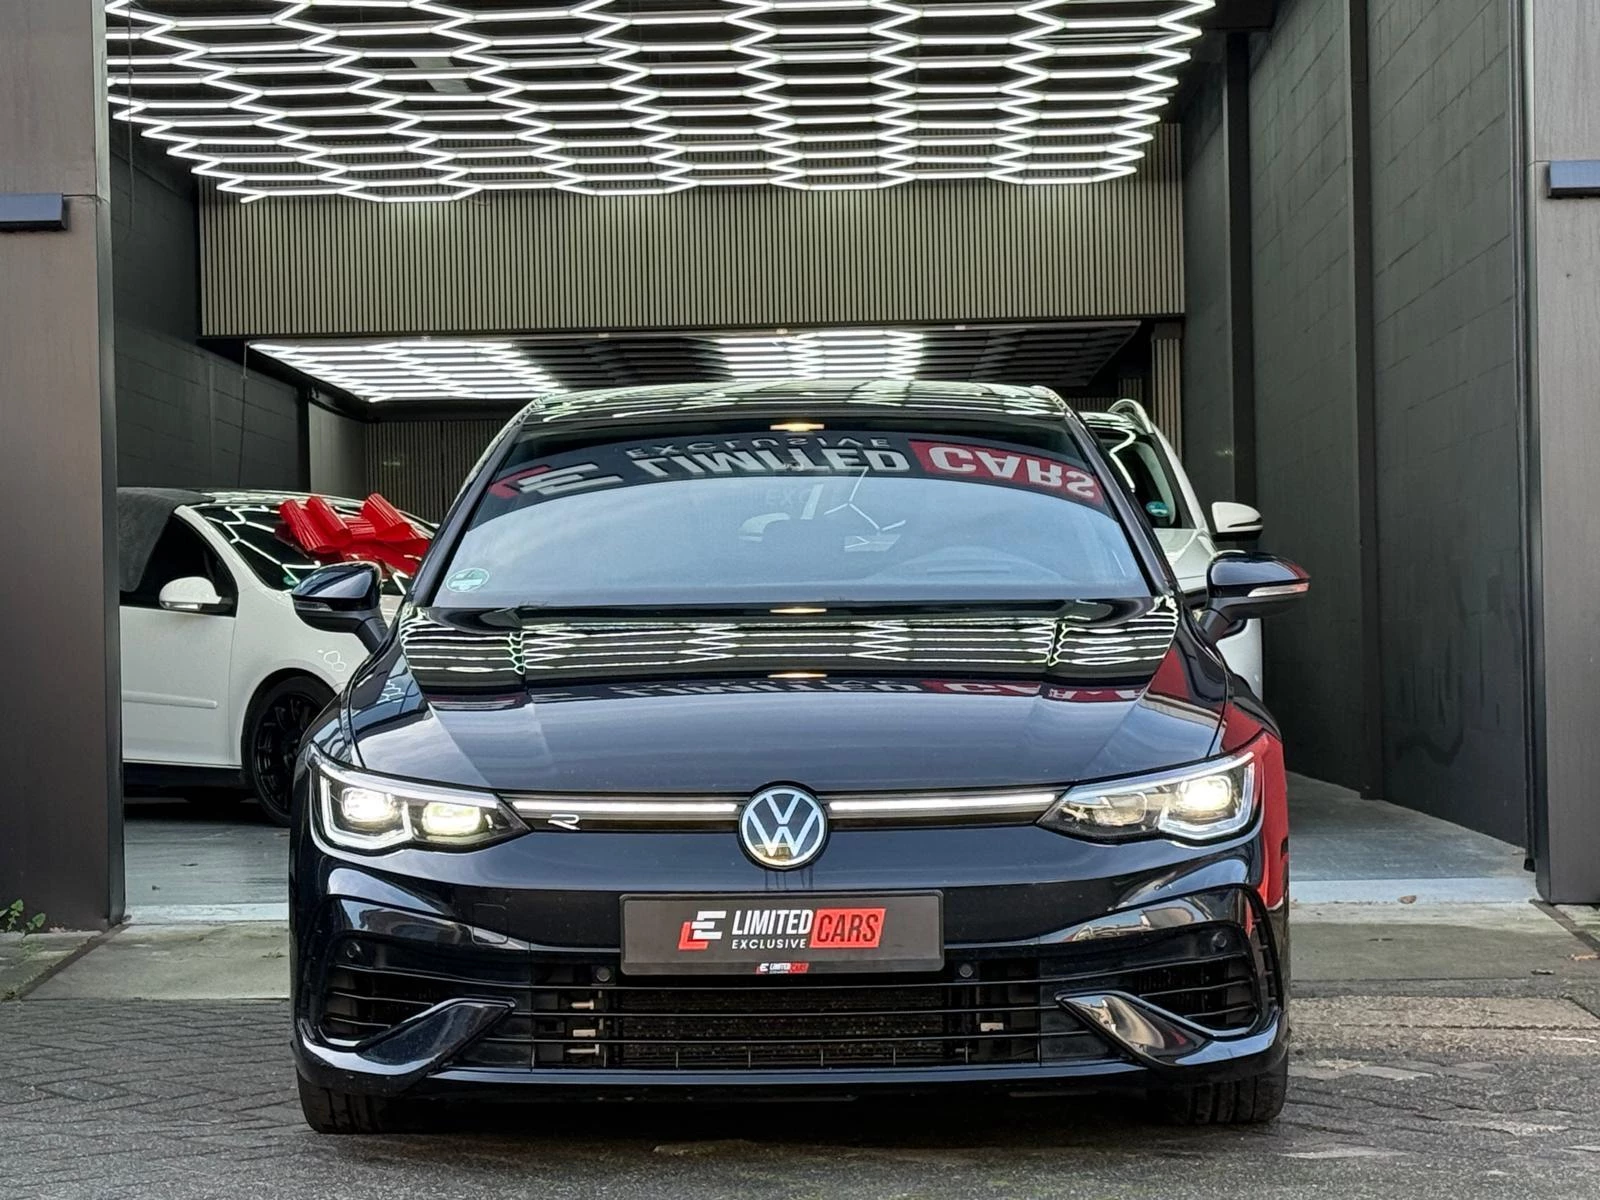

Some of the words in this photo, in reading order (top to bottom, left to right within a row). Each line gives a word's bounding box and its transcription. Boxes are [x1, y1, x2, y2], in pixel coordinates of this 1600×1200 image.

[731, 909, 813, 935] LIMITED
[816, 914, 879, 942] CARS
[731, 938, 807, 949] EXCLUSIVE
